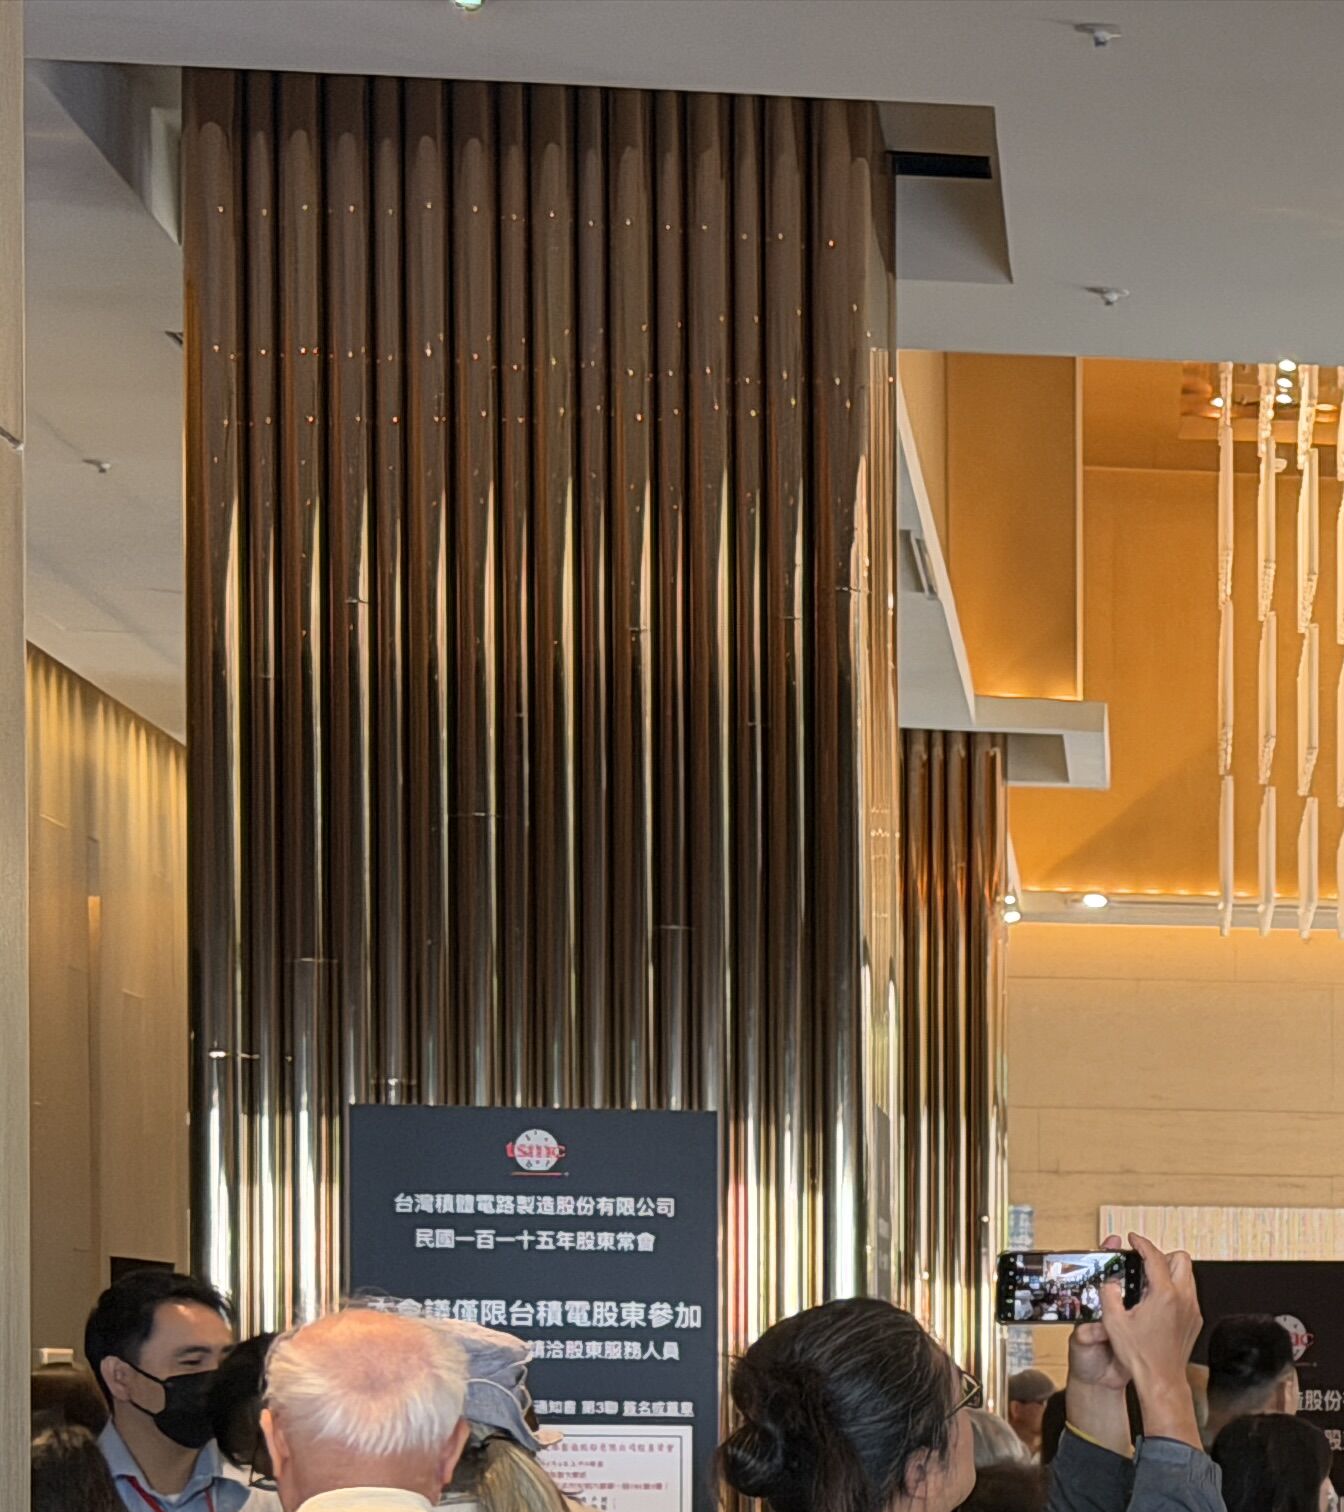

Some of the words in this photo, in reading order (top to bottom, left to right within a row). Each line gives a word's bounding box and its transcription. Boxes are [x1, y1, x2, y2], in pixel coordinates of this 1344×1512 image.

[394, 1193, 676, 1217] 台灣積體電路製造股份有限公司
[415, 1228, 656, 1252] 民國一百一十五年股東常會
